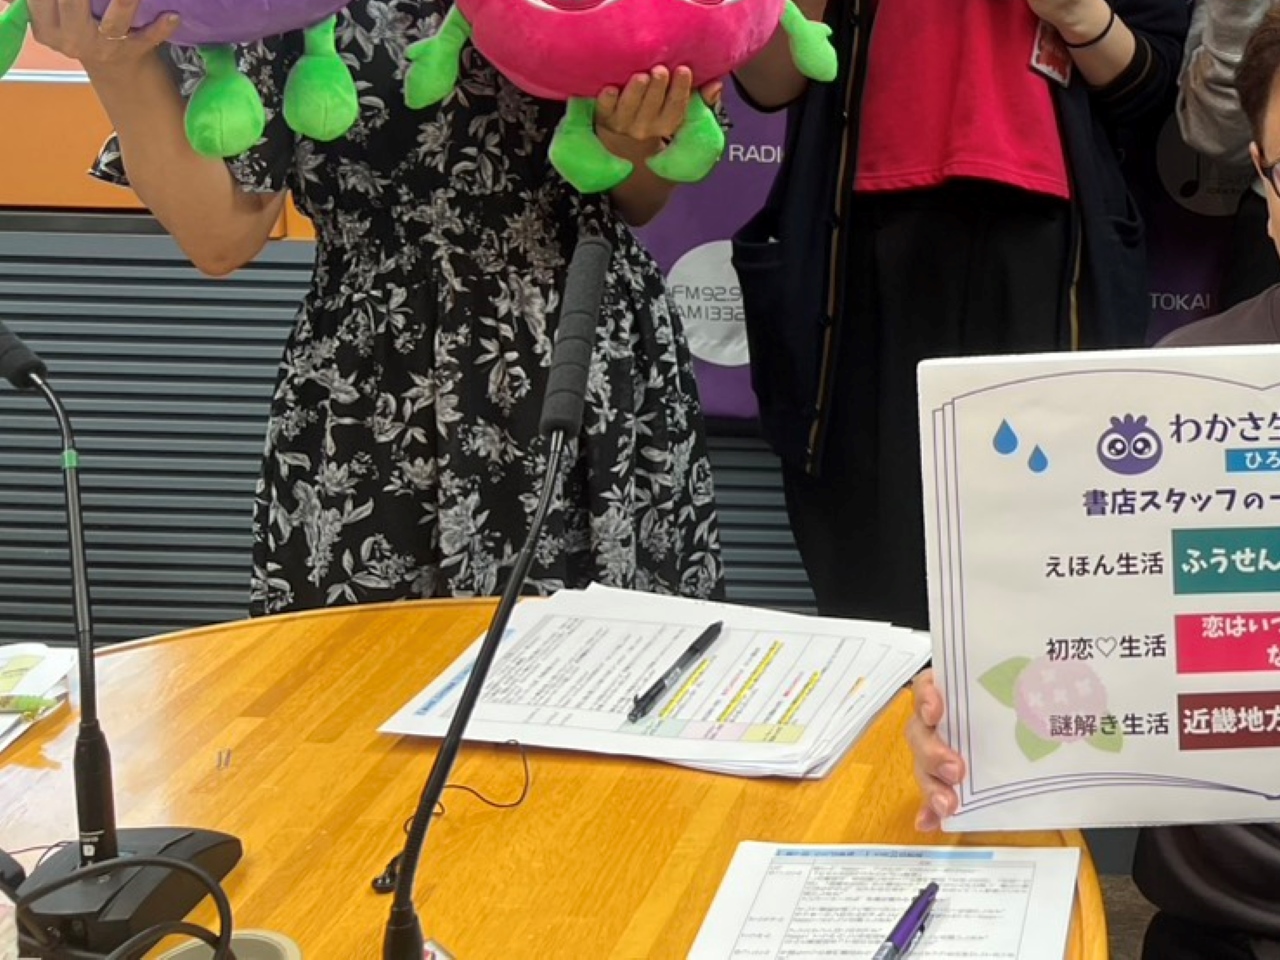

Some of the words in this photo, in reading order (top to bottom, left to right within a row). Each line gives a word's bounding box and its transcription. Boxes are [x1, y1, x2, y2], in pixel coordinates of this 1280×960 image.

[728, 144, 782, 163] RADI
[1149, 291, 1211, 311] TOKAI
[1045, 552, 1165, 578] えほん生活
[1048, 711, 1170, 737] 謎解き生活
